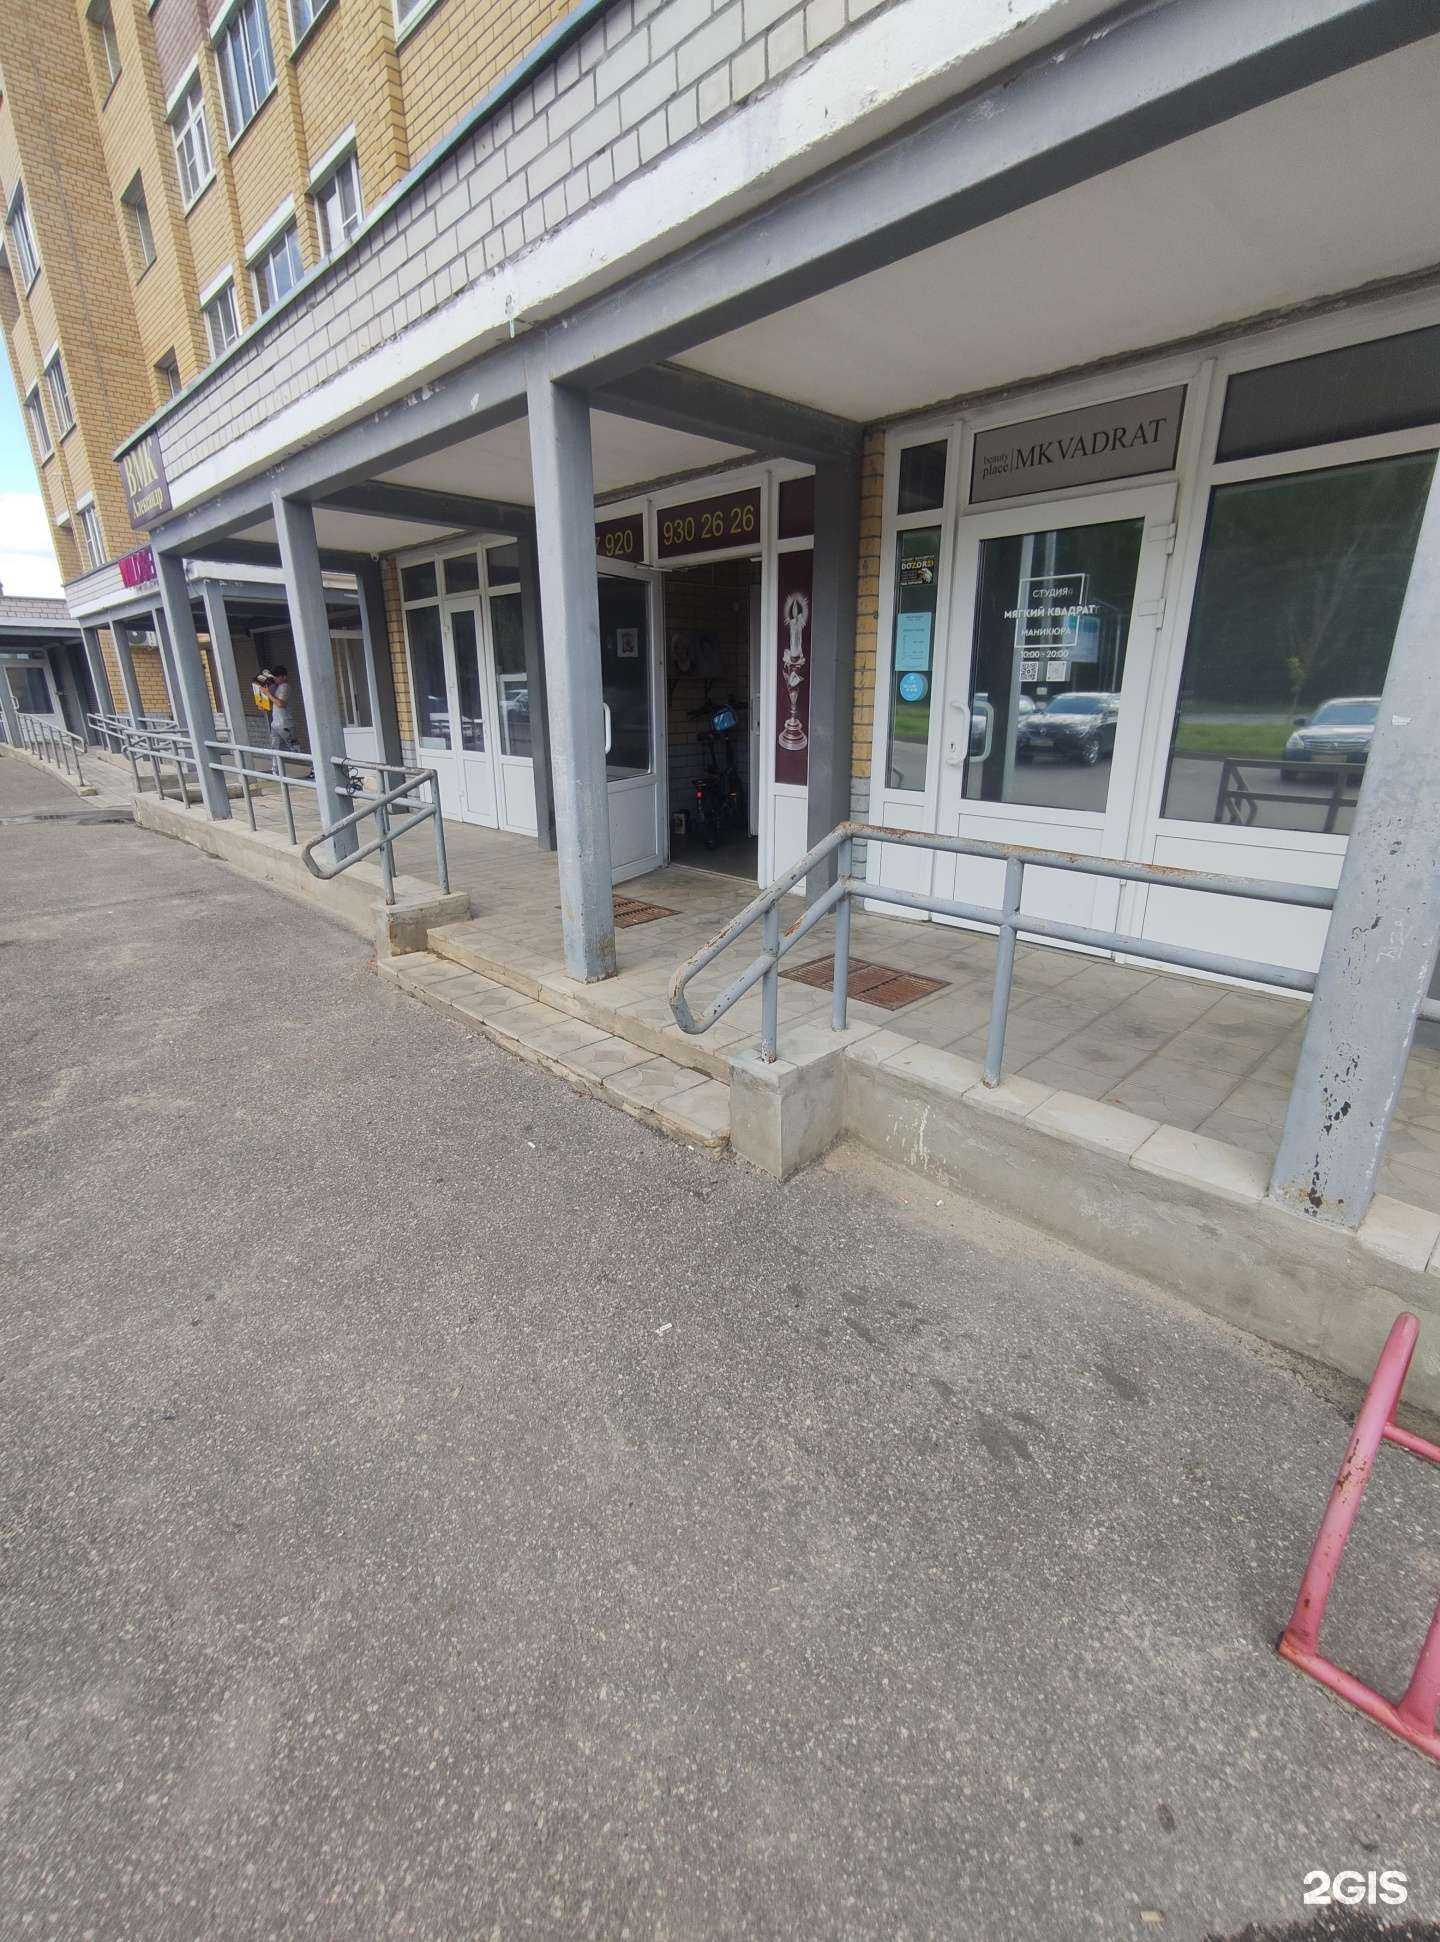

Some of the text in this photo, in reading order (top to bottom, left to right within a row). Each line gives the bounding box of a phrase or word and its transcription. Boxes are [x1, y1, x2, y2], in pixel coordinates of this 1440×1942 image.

[983, 462, 1009, 480] place
[605, 505, 754, 556] 920 930 26 26
[1032, 587, 1069, 598] СТУДИЯ
[1004, 605, 1096, 619] МЯГКИЙ КВАДРАТ
